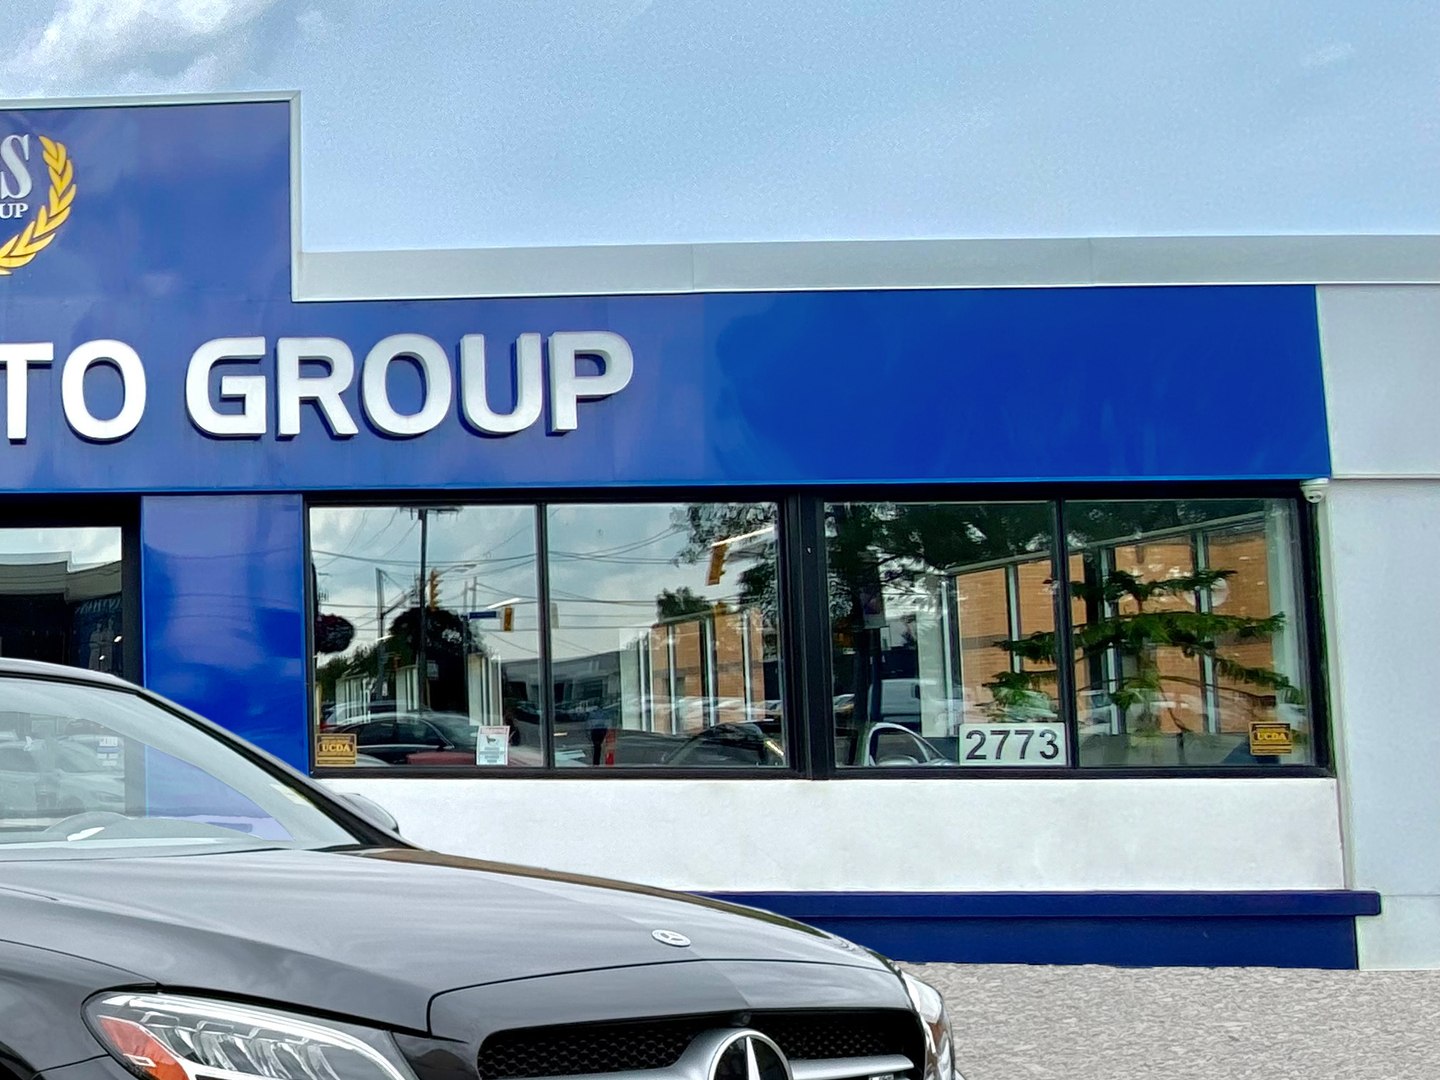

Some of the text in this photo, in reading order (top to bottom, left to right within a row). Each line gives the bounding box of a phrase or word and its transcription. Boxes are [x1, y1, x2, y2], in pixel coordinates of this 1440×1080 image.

[185, 331, 635, 438] GROUP
[965, 729, 1060, 760] 2773
[1257, 732, 1288, 741] UCDA
[322, 743, 351, 752] UCDA
